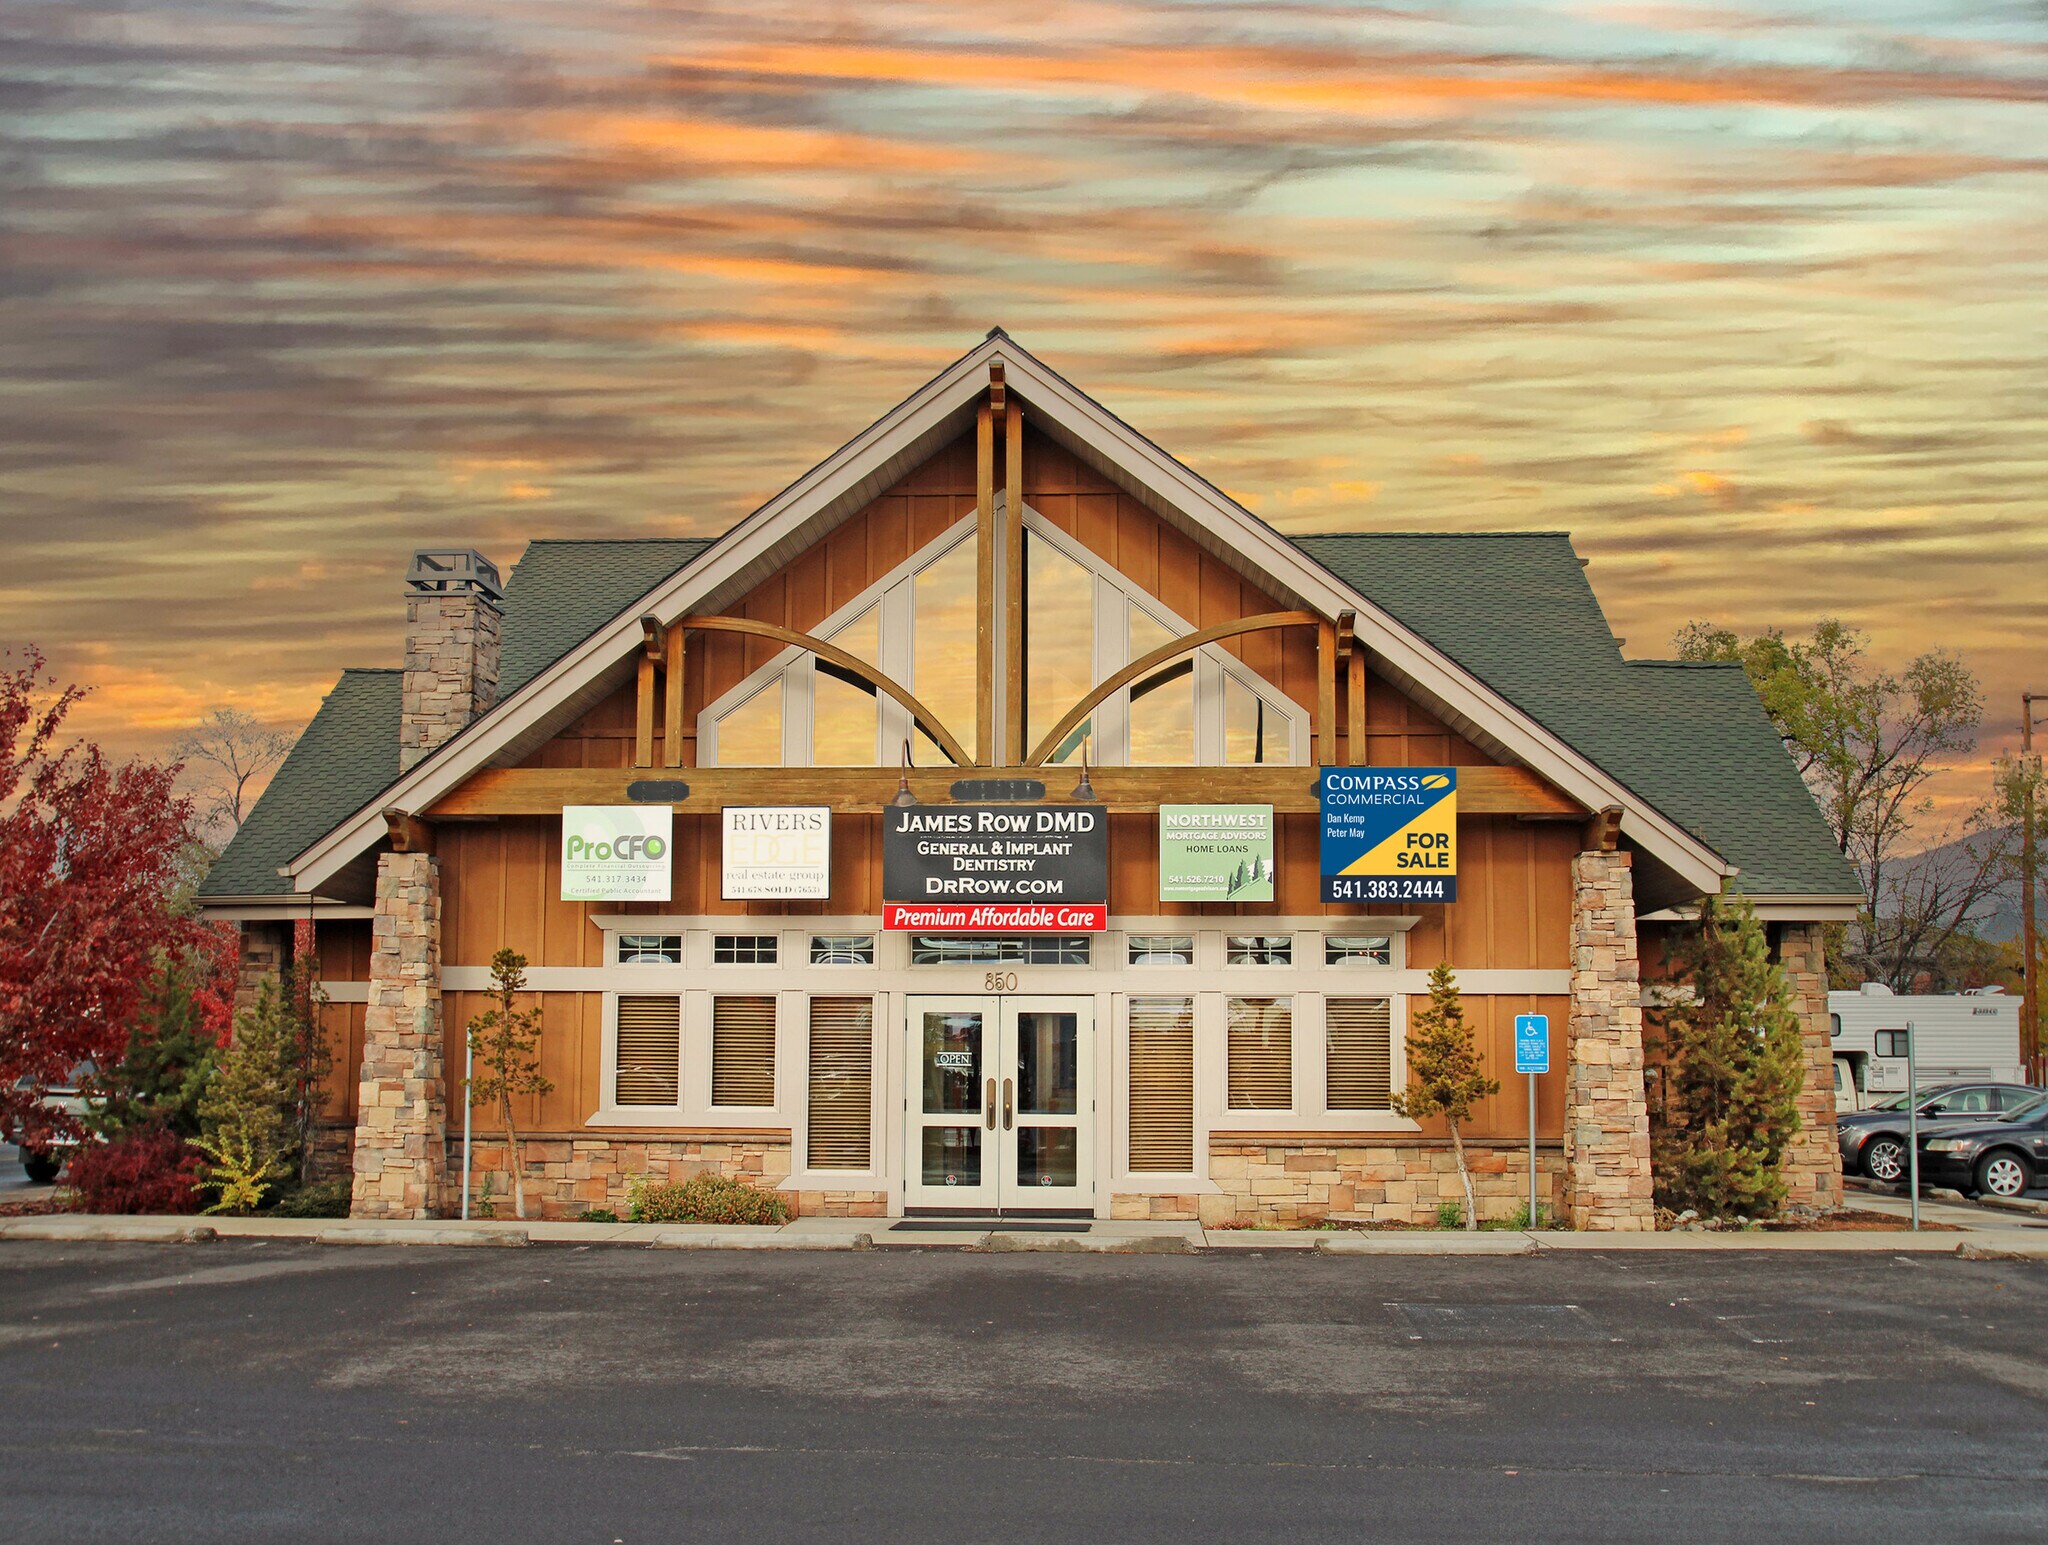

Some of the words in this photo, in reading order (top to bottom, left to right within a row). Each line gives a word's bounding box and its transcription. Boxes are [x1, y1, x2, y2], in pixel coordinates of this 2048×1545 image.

[1326, 774, 1420, 791] COMPASS
[1326, 793, 1425, 805] COMMERCIAL
[732, 813, 822, 831] RIVERS
[1036, 812, 1095, 833] DMD
[1166, 814, 1267, 827] NORTHWEST
[1327, 813, 1342, 824] Dan
[1343, 813, 1365, 825] Kemp
[1166, 831, 1218, 840] MORTGAGE
[1220, 831, 1267, 840] ADVISORS
[1327, 828, 1347, 838] Peter
[1349, 828, 1365, 839] May
[1406, 833, 1449, 849] FOR
[567, 834, 667, 860] ProCFO
[730, 833, 823, 865] EDGE
[991, 841, 1003, 855] &
[1186, 845, 1214, 853] HOME
[1217, 845, 1249, 853] LOANS
[1396, 852, 1449, 869] SALE
[586, 875, 647, 883] 541.317.3434
[726, 869, 748, 880] real
[751, 871, 786, 880] estate
[789, 872, 824, 882] group
[1332, 881, 1444, 898] 541.383.2444
[894, 908, 967, 926] Premium
[969, 908, 1054, 926] Affordable
[1057, 908, 1095, 926] Care
[985, 972, 1018, 991] 850
[939, 1054, 969, 1064] OPEN
